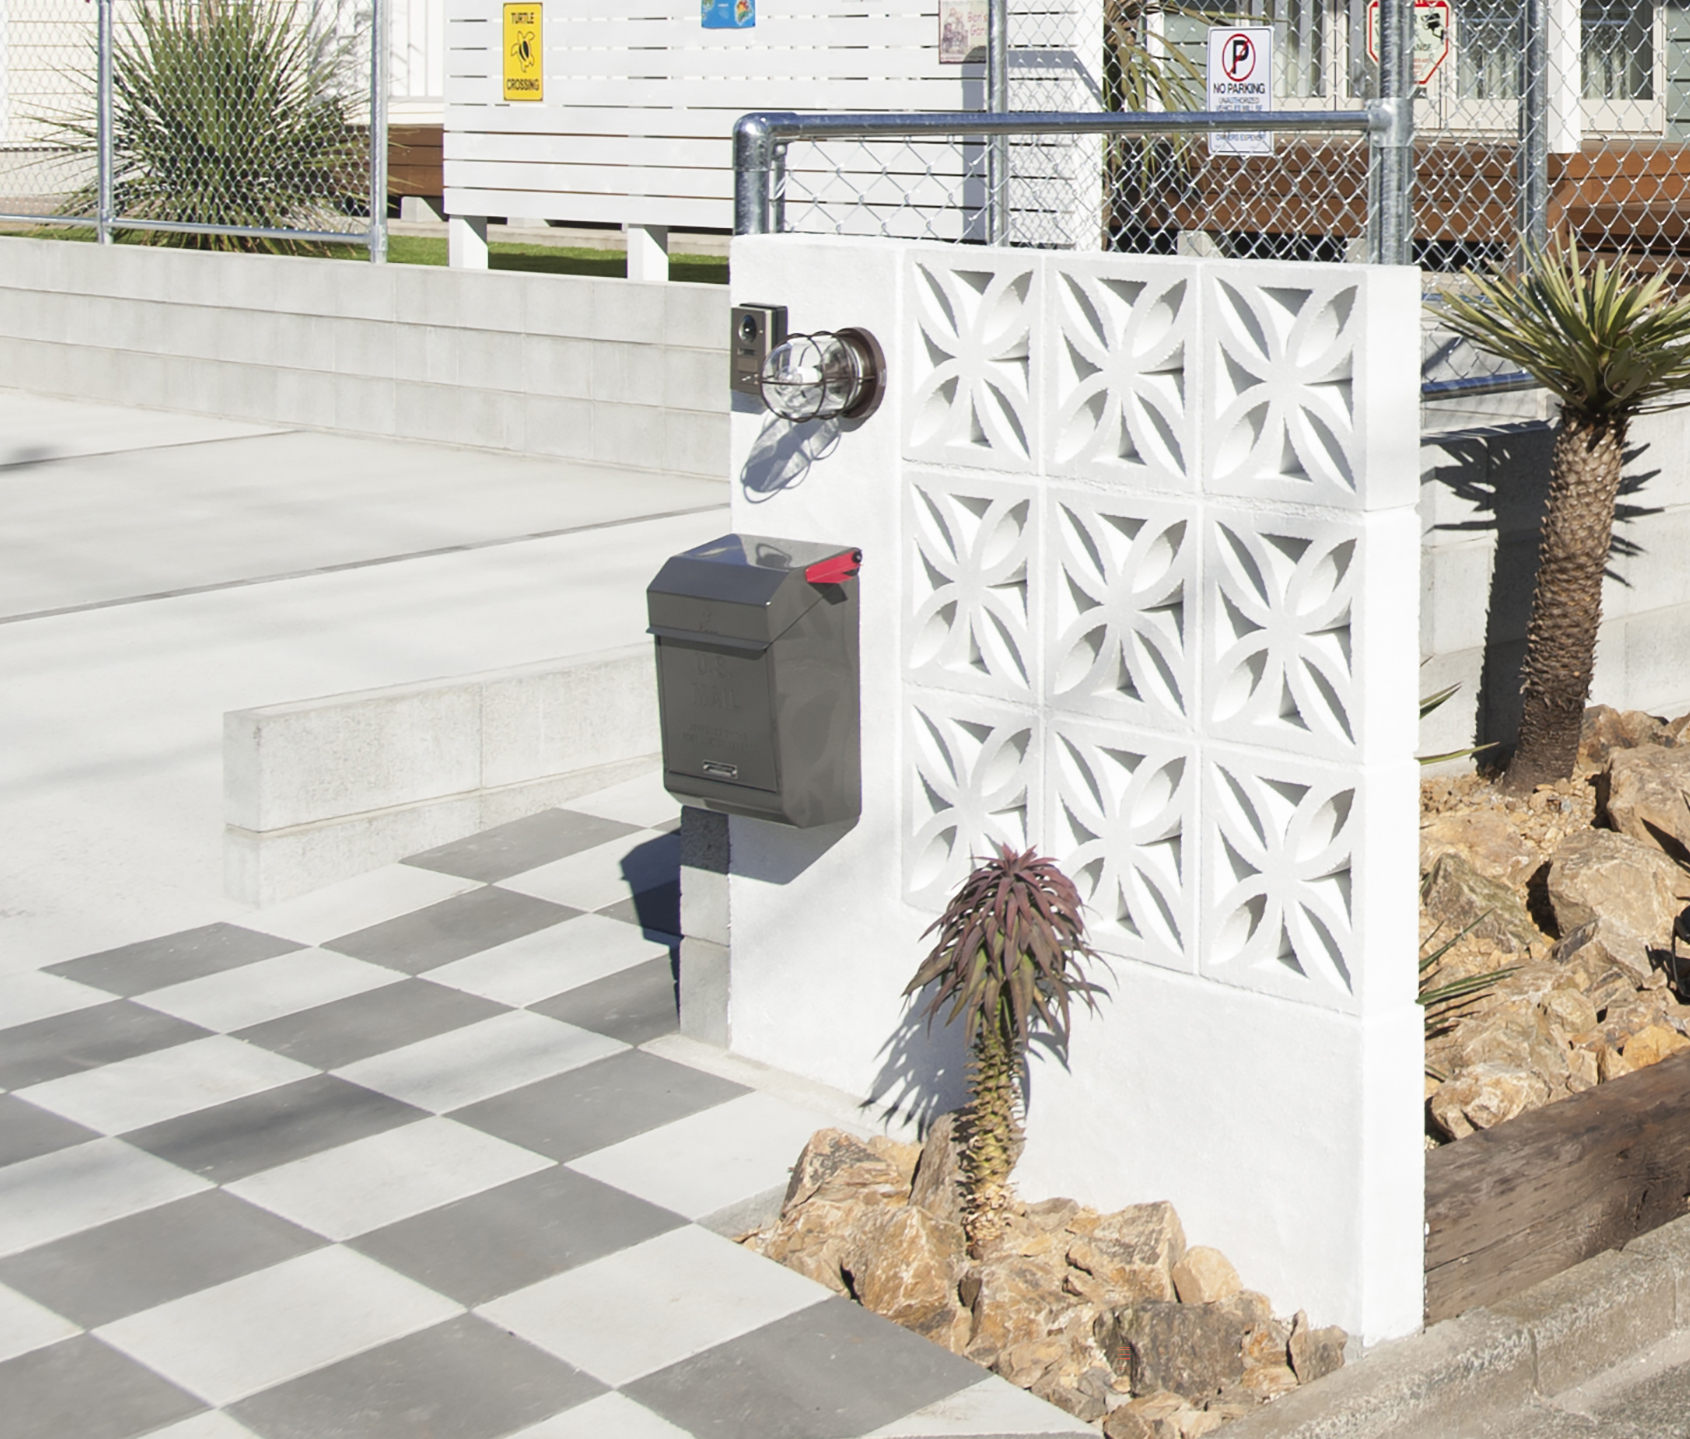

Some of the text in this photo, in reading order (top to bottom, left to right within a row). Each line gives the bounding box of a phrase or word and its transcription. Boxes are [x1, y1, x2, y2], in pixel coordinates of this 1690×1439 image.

[511, 12, 534, 24] TURTLE
[507, 79, 539, 91] CROSSING
[1213, 83, 1265, 94] NO PARKING
[691, 681, 741, 712] MAIL
